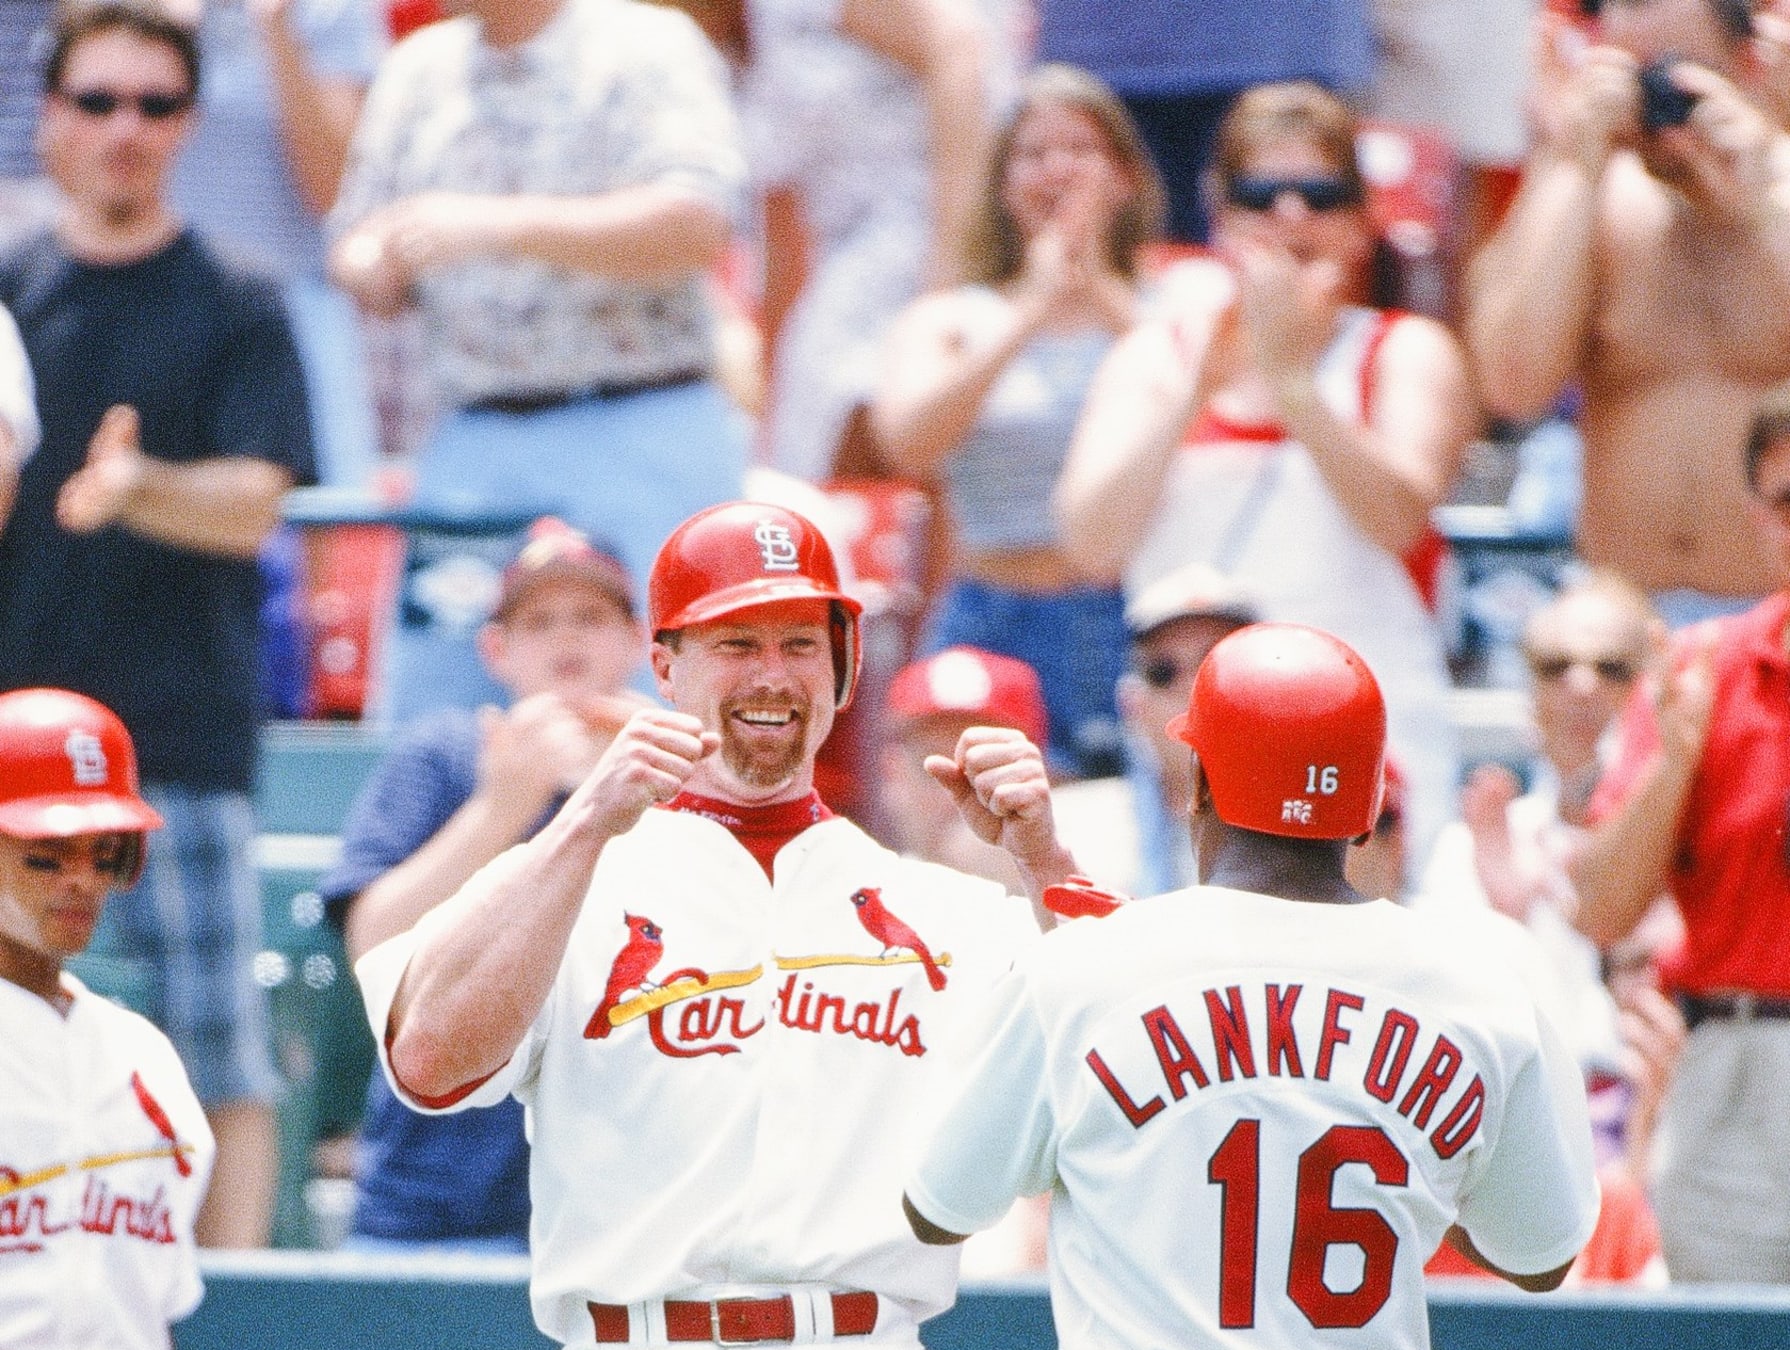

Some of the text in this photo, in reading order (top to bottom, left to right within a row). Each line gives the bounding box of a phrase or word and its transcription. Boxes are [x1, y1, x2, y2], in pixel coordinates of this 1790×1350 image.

[1305, 765, 1339, 794] 16
[1085, 983, 1486, 1160] LANKFORD
[1207, 1118, 1410, 1329] 16
